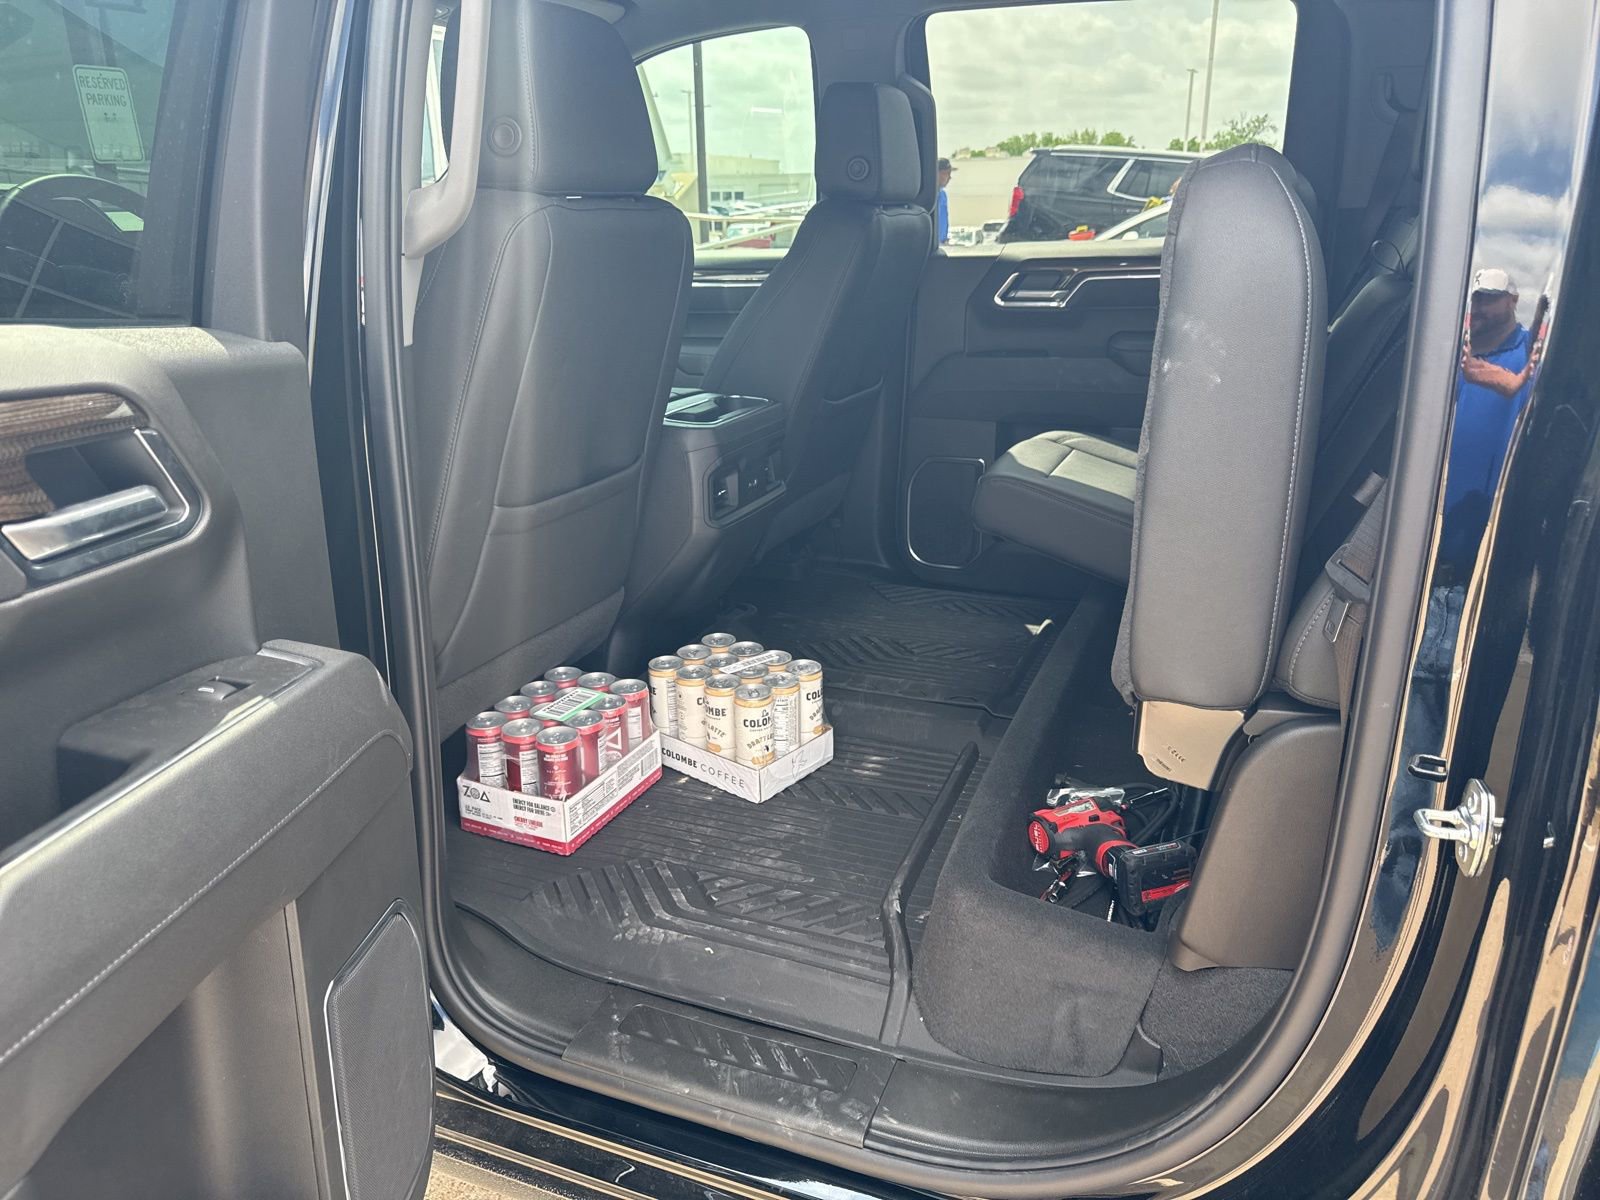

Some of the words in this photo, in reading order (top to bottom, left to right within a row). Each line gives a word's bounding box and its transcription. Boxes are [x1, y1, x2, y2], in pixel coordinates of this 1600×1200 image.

[78, 75, 126, 91] RESERVED
[86, 92, 127, 107] PARKING
[661, 747, 698, 768] COLOMBE
[700, 763, 745, 789] COFFEE
[462, 785, 491, 803] ZOA
